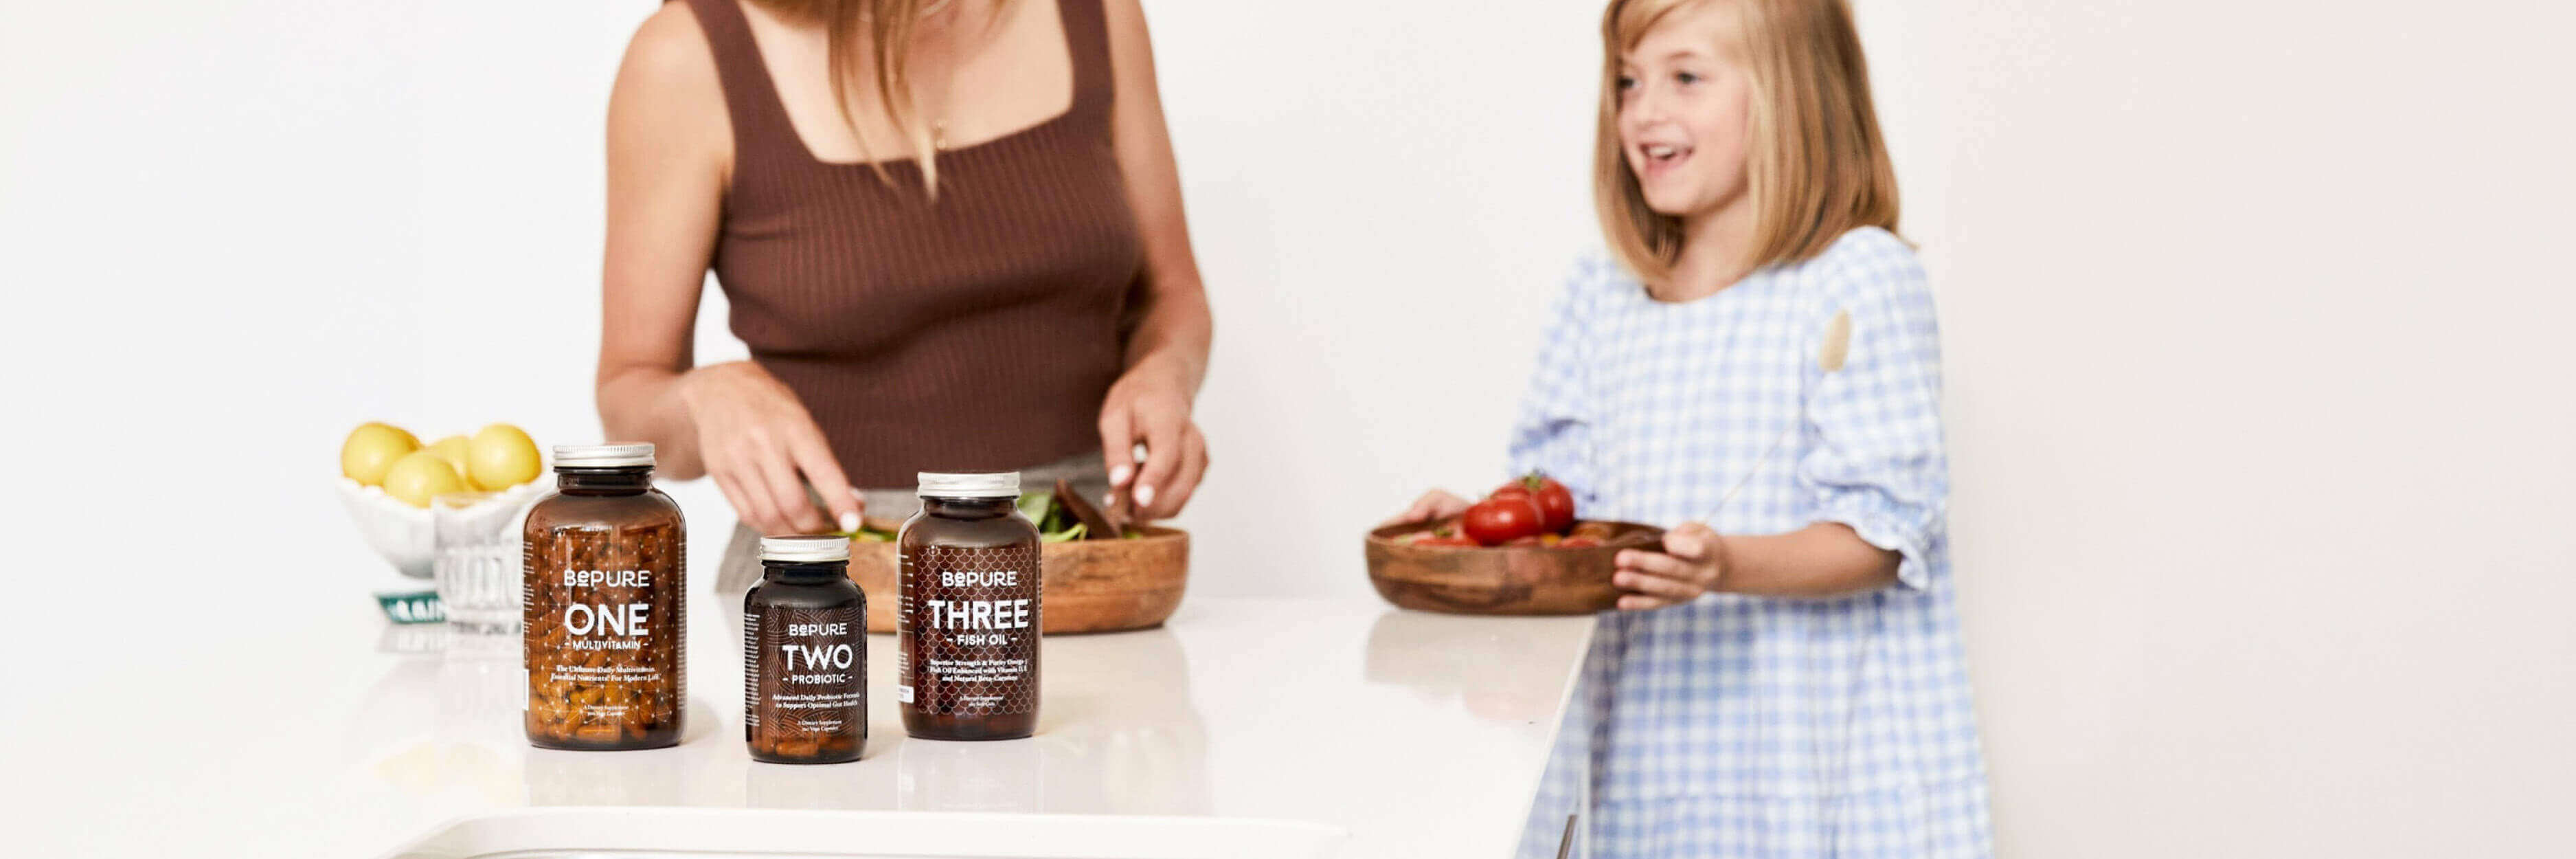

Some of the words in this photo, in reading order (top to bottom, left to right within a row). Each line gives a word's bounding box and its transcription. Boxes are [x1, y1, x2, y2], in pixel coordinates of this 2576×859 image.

[564, 603, 649, 636] ONE
[927, 599, 1028, 630] THREE
[957, 635, 984, 645] FISH
[988, 634, 1008, 645] OIL
[572, 640, 640, 651] MULTIVITAMIN
[782, 644, 853, 671] TWO
[955, 659, 981, 667] Strength
[569, 665, 595, 673] Ultimate
[596, 667, 613, 676] Daily
[623, 674, 646, 682] Modern
[791, 674, 846, 684] PROBIOTIC
[800, 693, 816, 702] Daily
[783, 702, 806, 710] Support
[807, 701, 831, 710] Optimal
